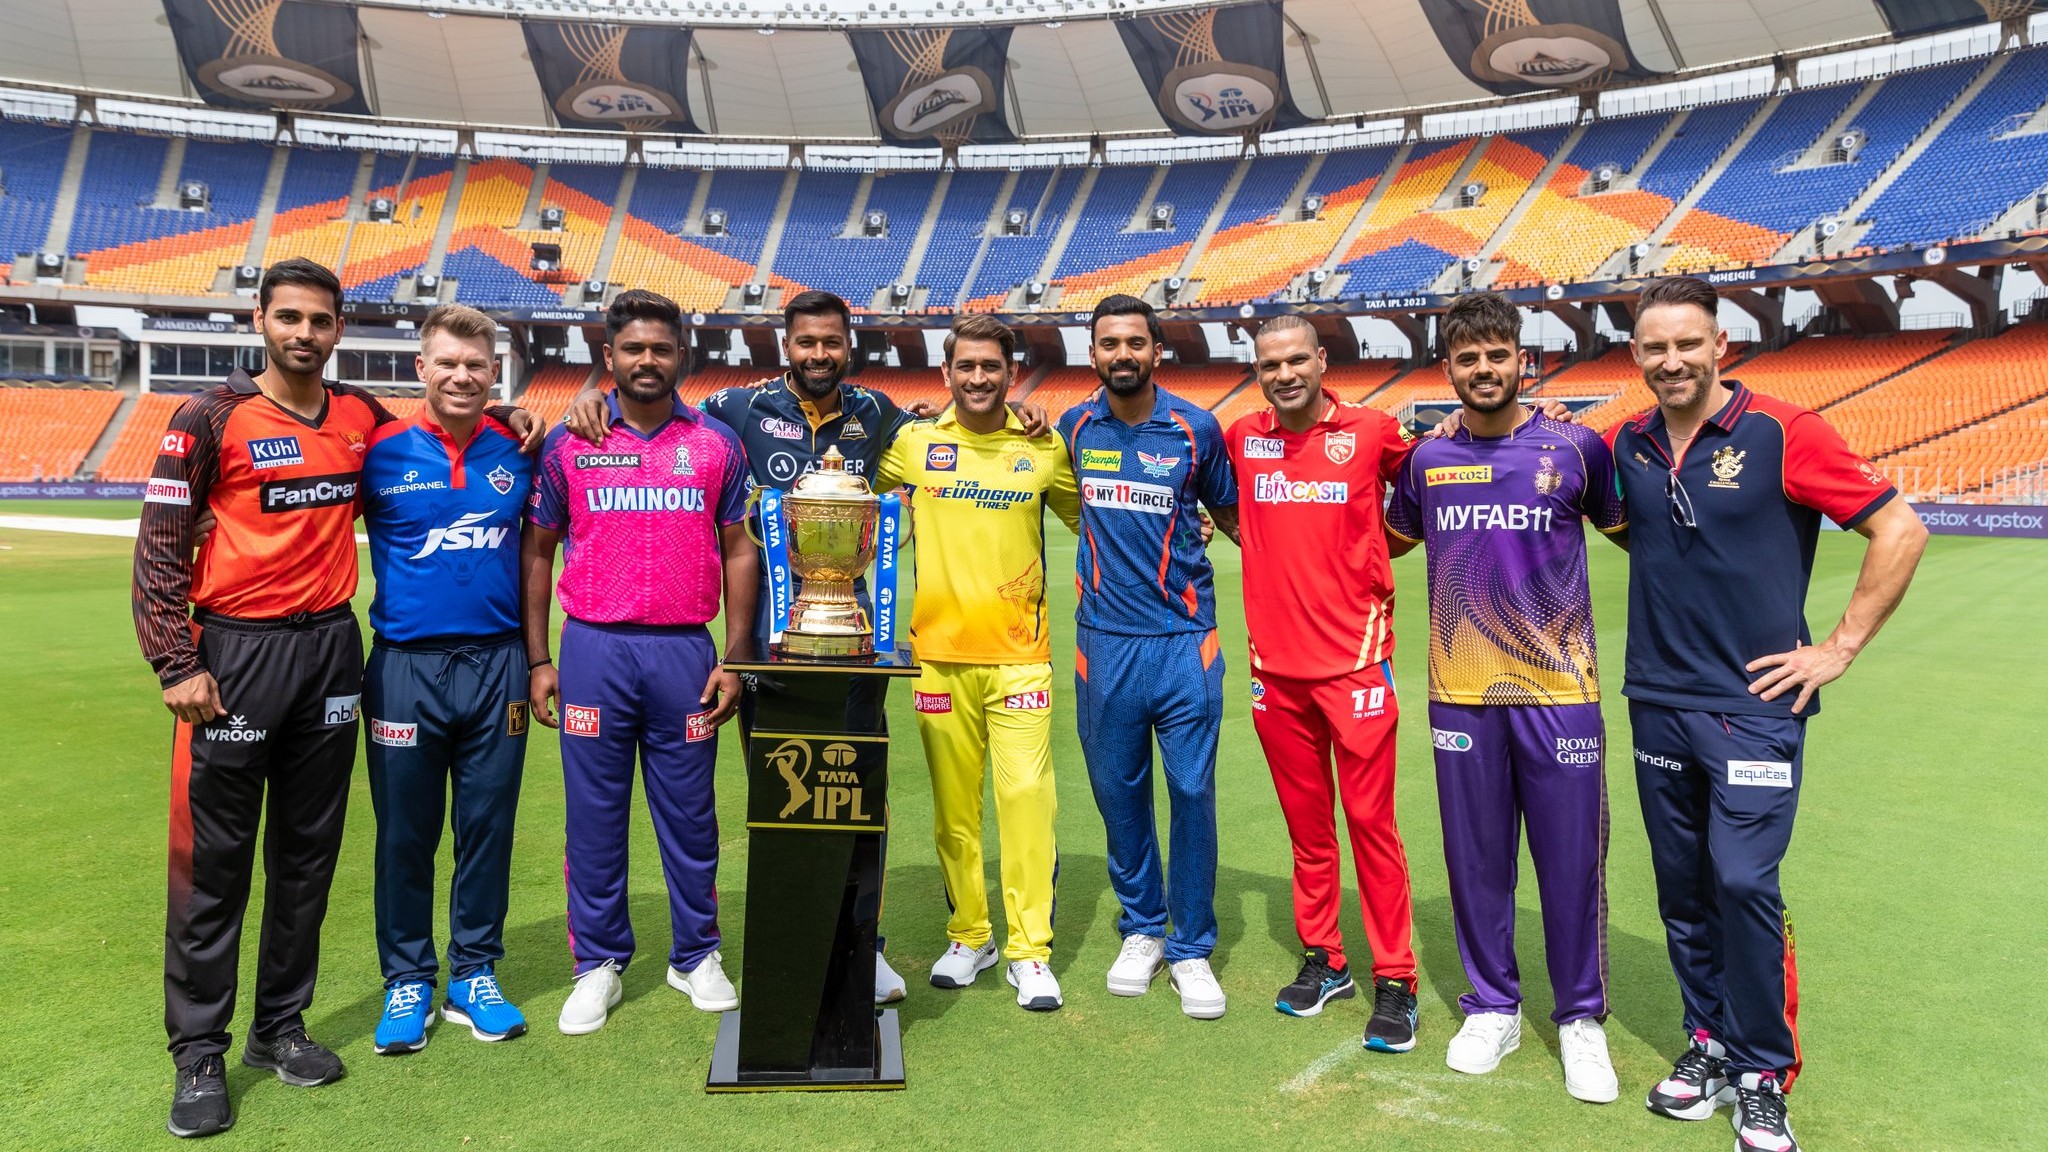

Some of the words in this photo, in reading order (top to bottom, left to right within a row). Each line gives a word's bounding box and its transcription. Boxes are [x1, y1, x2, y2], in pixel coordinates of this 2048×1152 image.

[1219, 103, 1265, 119] IPL
[342, 304, 357, 312] GT
[381, 305, 408, 315] 15-0
[1365, 301, 1387, 309] TATA
[1388, 299, 1401, 307] IPL
[1404, 298, 1426, 307] 2023
[531, 311, 585, 321] AHMEDABAD
[153, 319, 225, 332] AHMEDABAD
[762, 419, 803, 433] CAPRI
[775, 431, 802, 439] LOANS
[1328, 438, 1352, 446] KINGS
[252, 439, 298, 459] Kühl
[1246, 438, 1283, 451] LOTUS
[589, 455, 639, 466] DOLLAR
[929, 453, 954, 461] Gulf
[1082, 451, 1120, 467] Greenply
[803, 459, 864, 474] ATER
[379, 481, 447, 496] GREENPANEL
[941, 487, 1033, 503] EUROGRIP
[586, 487, 705, 512] LUMINOUS
[975, 501, 1010, 510] TYRES
[1437, 504, 1552, 532] MYFAB11
[1919, 510, 1969, 526] pstox
[1972, 510, 2043, 530] upstox
[767, 513, 781, 548] TATA
[409, 527, 508, 560] JSW
[882, 536, 894, 570] TATA
[777, 584, 787, 620] TATA
[880, 607, 892, 642] TATA
[1006, 690, 1049, 708] SNJ
[567, 708, 597, 720] GOEL
[688, 714, 707, 726] GO
[373, 720, 415, 740] Galaxy
[569, 720, 593, 732] TMT
[692, 724, 710, 737] TMT
[205, 728, 266, 741] WROGN
[1556, 737, 1599, 752] ROYAL
[1556, 751, 1599, 763] GREEN
[817, 771, 859, 783] TATA
[1735, 768, 1787, 782] equitas
[813, 786, 871, 820] IPL
